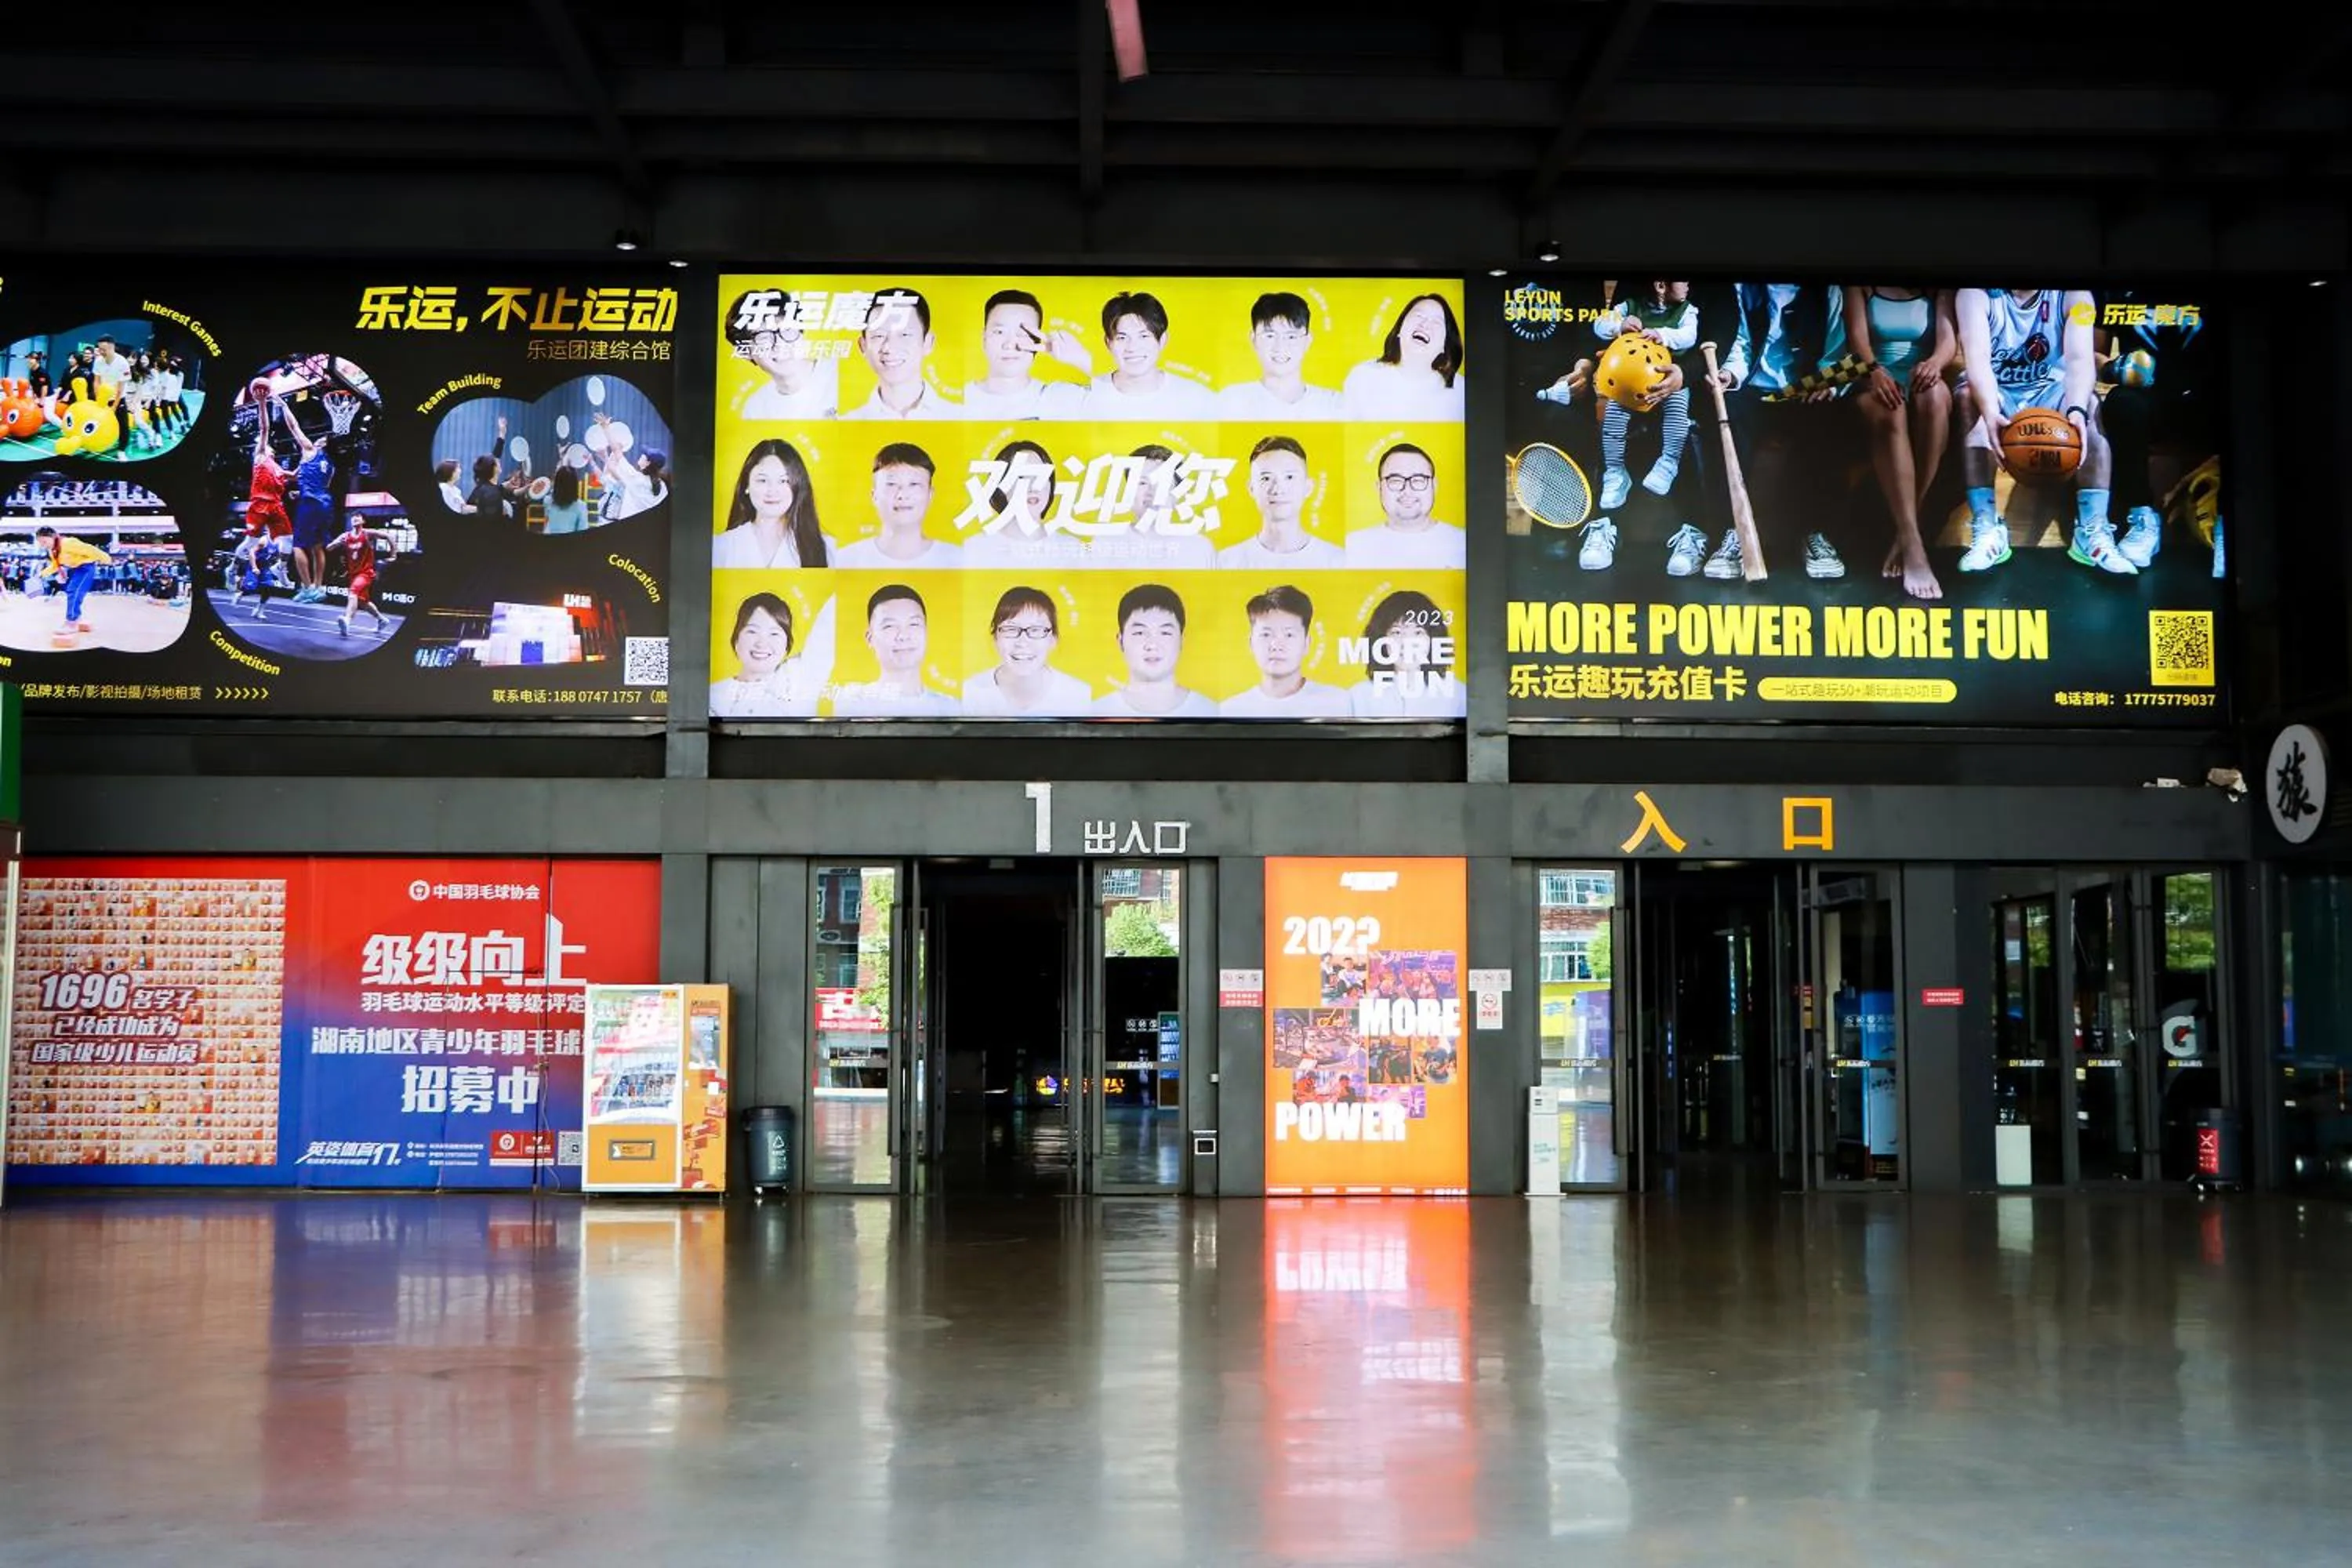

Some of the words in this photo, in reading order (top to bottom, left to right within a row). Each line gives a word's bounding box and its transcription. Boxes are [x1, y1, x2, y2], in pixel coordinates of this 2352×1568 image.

[734, 291, 919, 331] 乐运魔方
[1504, 289, 1562, 304] LEYUN
[1504, 308, 1573, 322] SPORTS
[1578, 309, 1621, 322] PA
[143, 299, 191, 326] Interest
[191, 320, 222, 358] Games
[527, 339, 672, 361] 乐运团建综合馆
[417, 383, 449, 416] Team
[448, 372, 503, 391] Building
[953, 452, 1238, 536] 欢迎您
[608, 554, 661, 603] Colocation
[1405, 609, 1454, 626] 2023
[1508, 601, 1638, 653] MORE
[1649, 604, 1813, 656] POWER
[1824, 606, 1953, 659] MORE
[1963, 608, 2049, 660] FUN
[209, 630, 280, 676] Competition
[1338, 637, 1455, 665] MORE
[1372, 670, 1454, 698] FUN
[1508, 664, 1748, 701] 乐运趣玩充值卡
[1025, 782, 1051, 853] 1
[1084, 820, 1186, 854] 出入口
[1621, 790, 1833, 854] 入口
[433, 884, 540, 901] 中国羽毛球协会
[361, 913, 587, 986] 级级向上
[42, 972, 132, 1010] 1696
[132, 989, 195, 1010] 名学子
[361, 991, 585, 1014] 羽毛球运动水平等级评定
[1359, 998, 1461, 1036] MORE
[31, 1042, 199, 1063] 国家级少儿运动员
[311, 1027, 583, 1055] 湖南地区青少年羽毛球
[401, 1065, 540, 1114] 招募中
[1275, 1102, 1406, 1142] POWER
